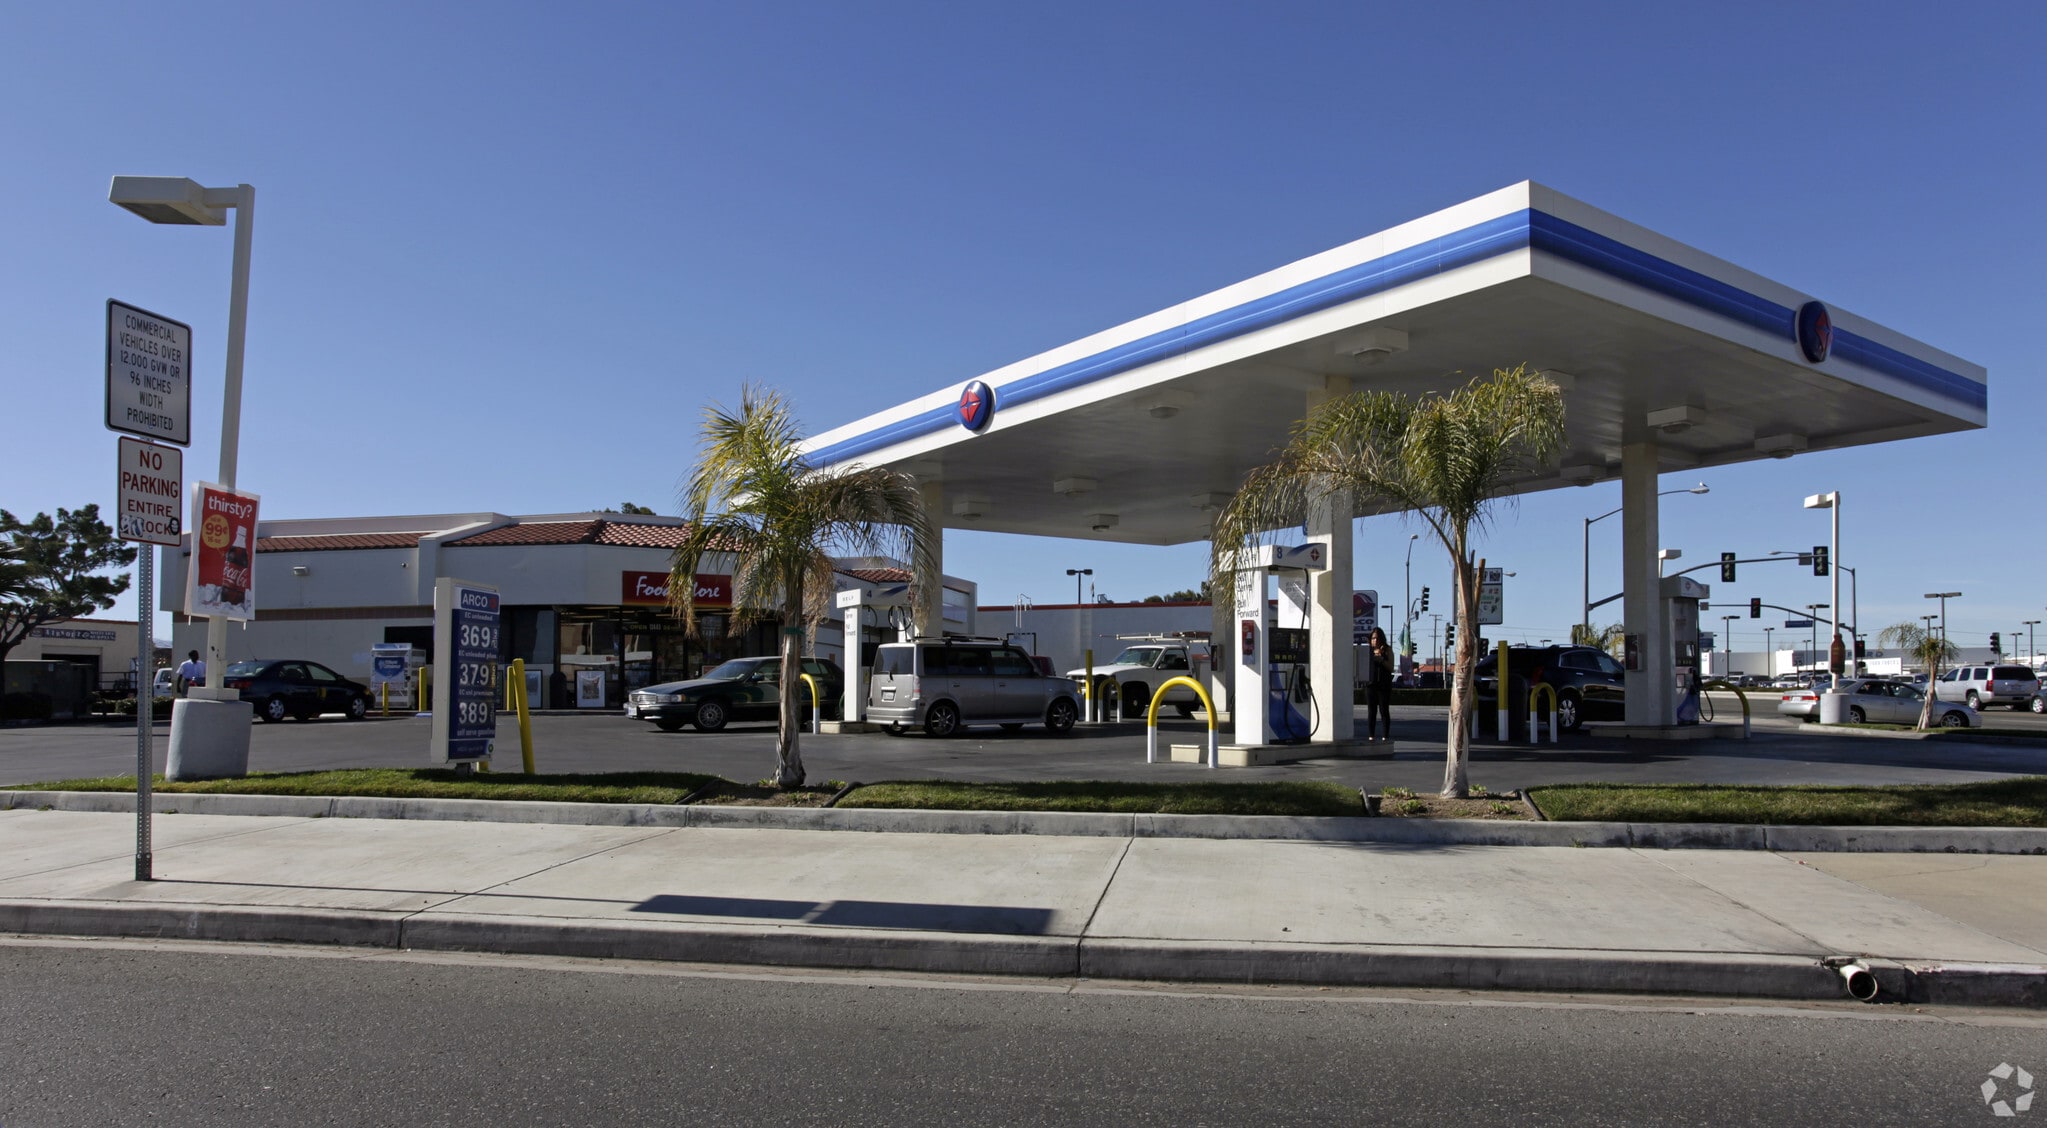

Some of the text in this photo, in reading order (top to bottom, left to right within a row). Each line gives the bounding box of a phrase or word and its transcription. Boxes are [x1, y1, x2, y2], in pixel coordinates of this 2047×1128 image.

[125, 314, 176, 343] COMMERCIAL
[119, 331, 181, 363] VEHICLES OVER
[150, 358, 167, 375] GVW
[169, 366, 180, 379] OR
[129, 370, 172, 394] 96 INCHES
[139, 390, 163, 410] WIDTH
[127, 407, 173, 431] PROHIBITED
[139, 450, 162, 470] NO
[122, 471, 179, 498] PARKING
[127, 498, 173, 518] ENTIRE
[208, 496, 253, 518] thirsty?
[1276, 547, 1283, 559] 8
[636, 576, 669, 597] Foo
[866, 590, 872, 598] 4
[462, 593, 488, 608] ARCO
[1237, 608, 1259, 618] Forward
[460, 624, 491, 648] 369
[459, 663, 489, 686] 379
[458, 701, 488, 724] 389
